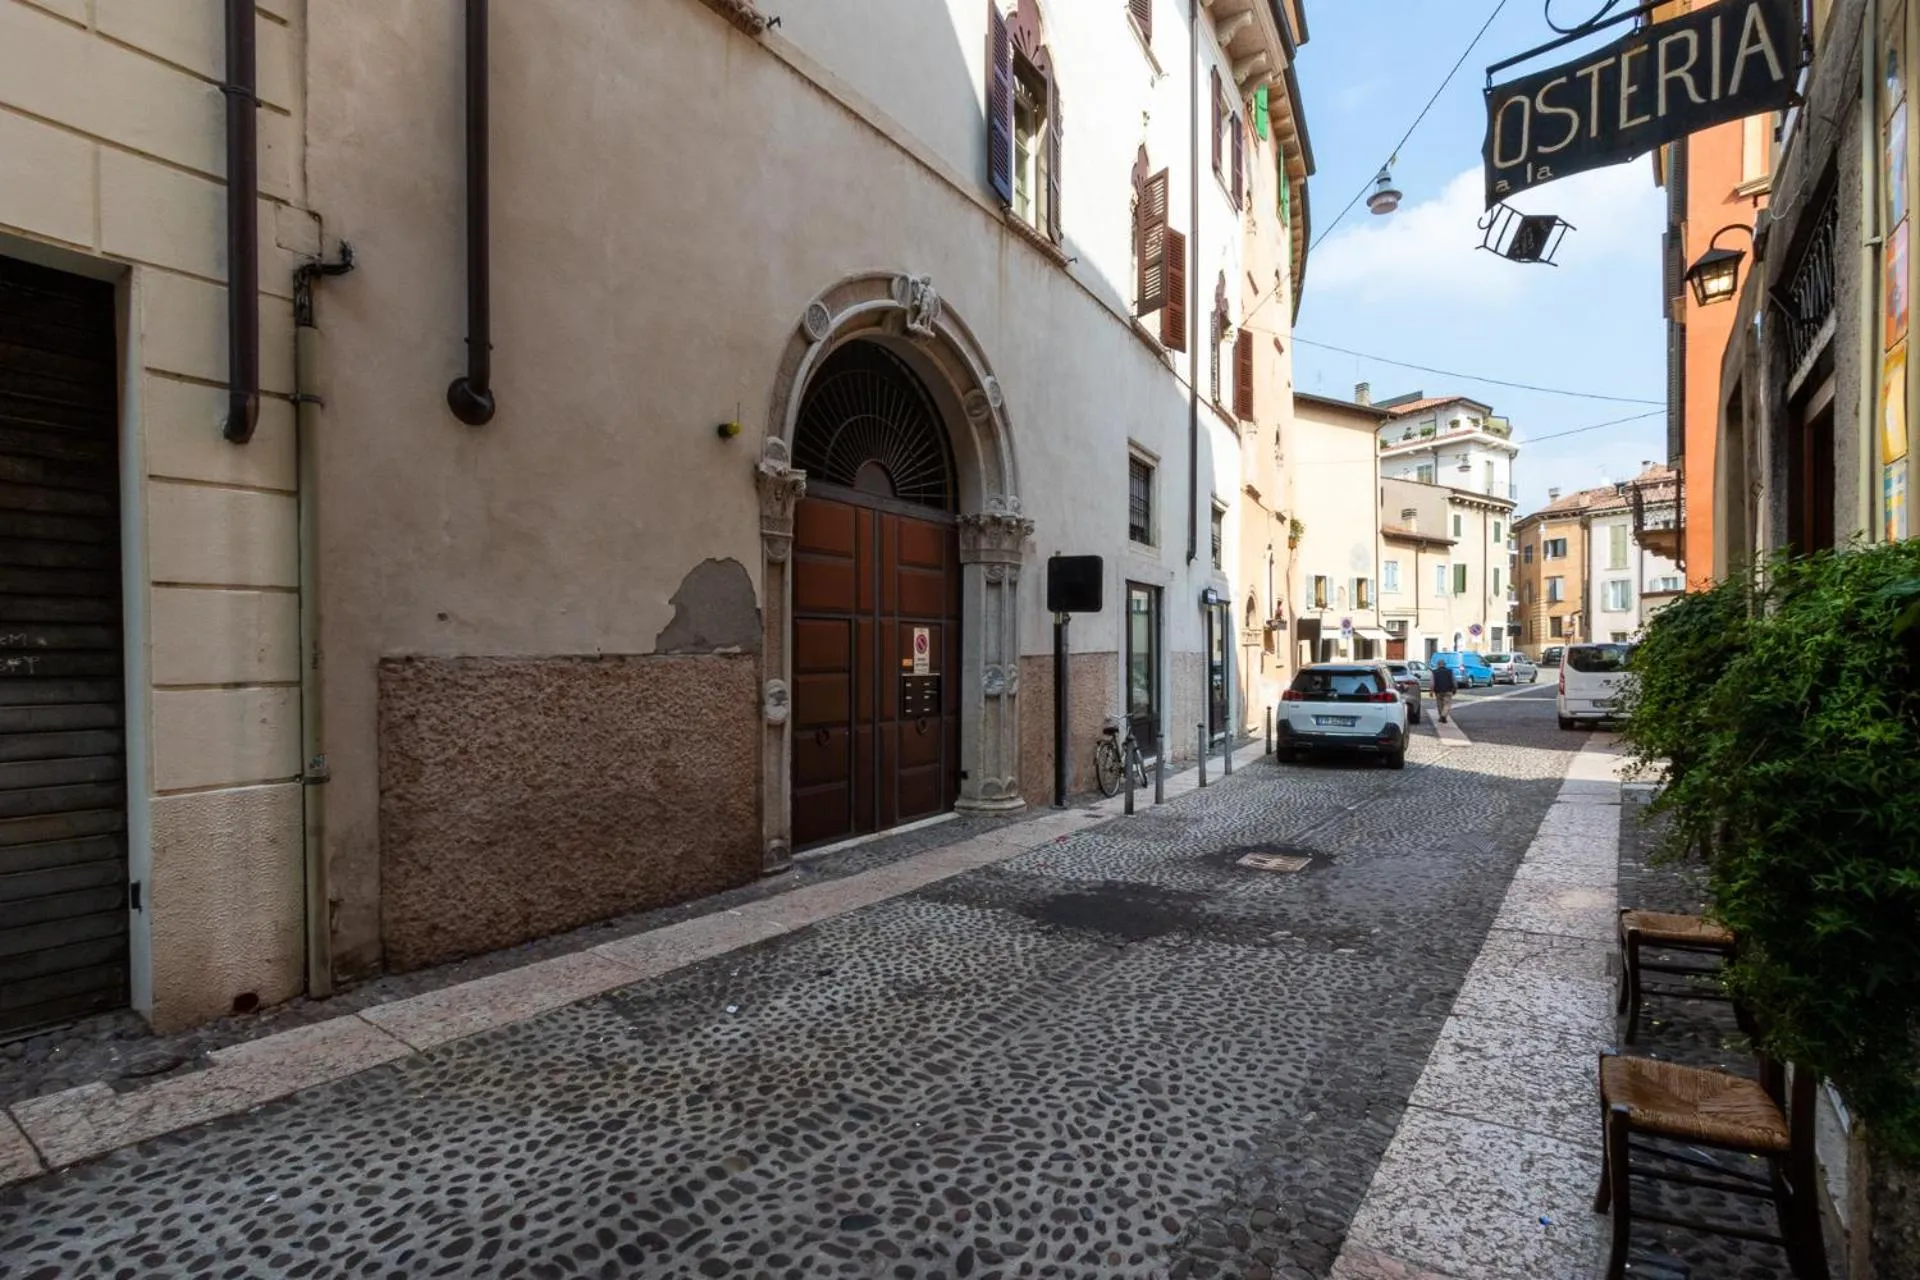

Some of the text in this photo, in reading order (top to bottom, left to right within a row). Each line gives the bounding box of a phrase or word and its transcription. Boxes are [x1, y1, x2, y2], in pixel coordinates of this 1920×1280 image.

[1493, 2, 1784, 169] OSTERIA
[1495, 161, 1553, 193] a la
